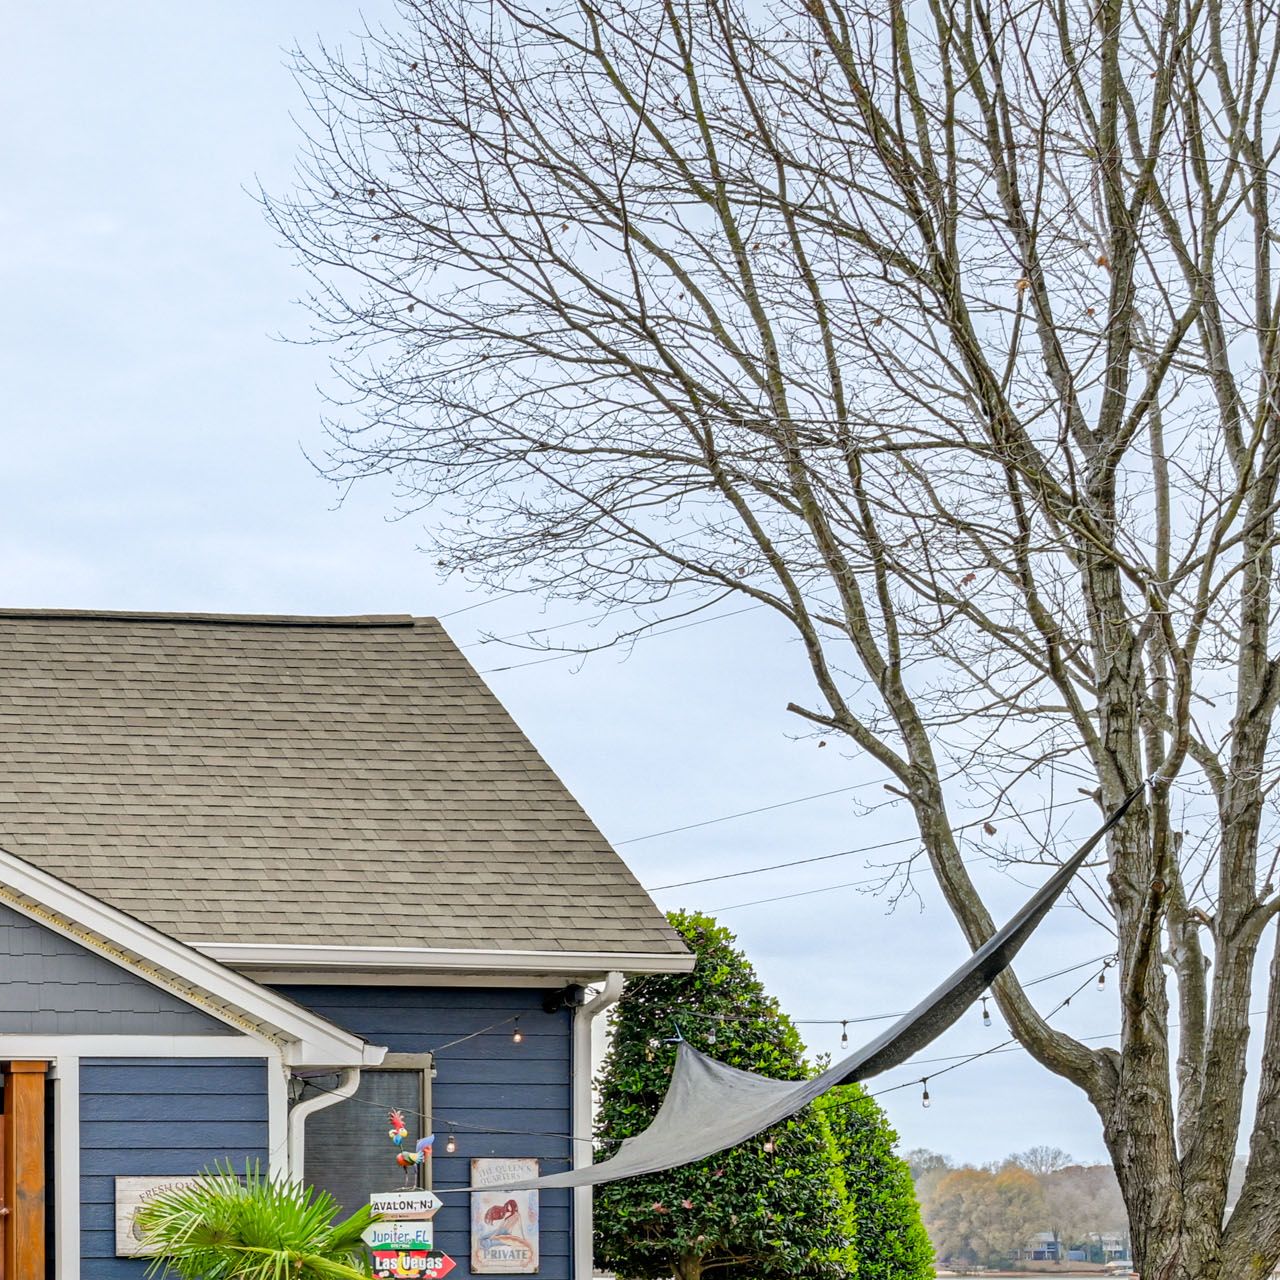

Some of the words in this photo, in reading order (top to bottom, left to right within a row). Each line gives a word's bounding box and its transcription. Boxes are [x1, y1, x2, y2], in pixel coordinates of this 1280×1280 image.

[420, 1200, 433, 1209] NJ
[416, 1230, 429, 1242] FL
[483, 1250, 528, 1260] PRIVATE
[375, 1256, 397, 1270] Las
